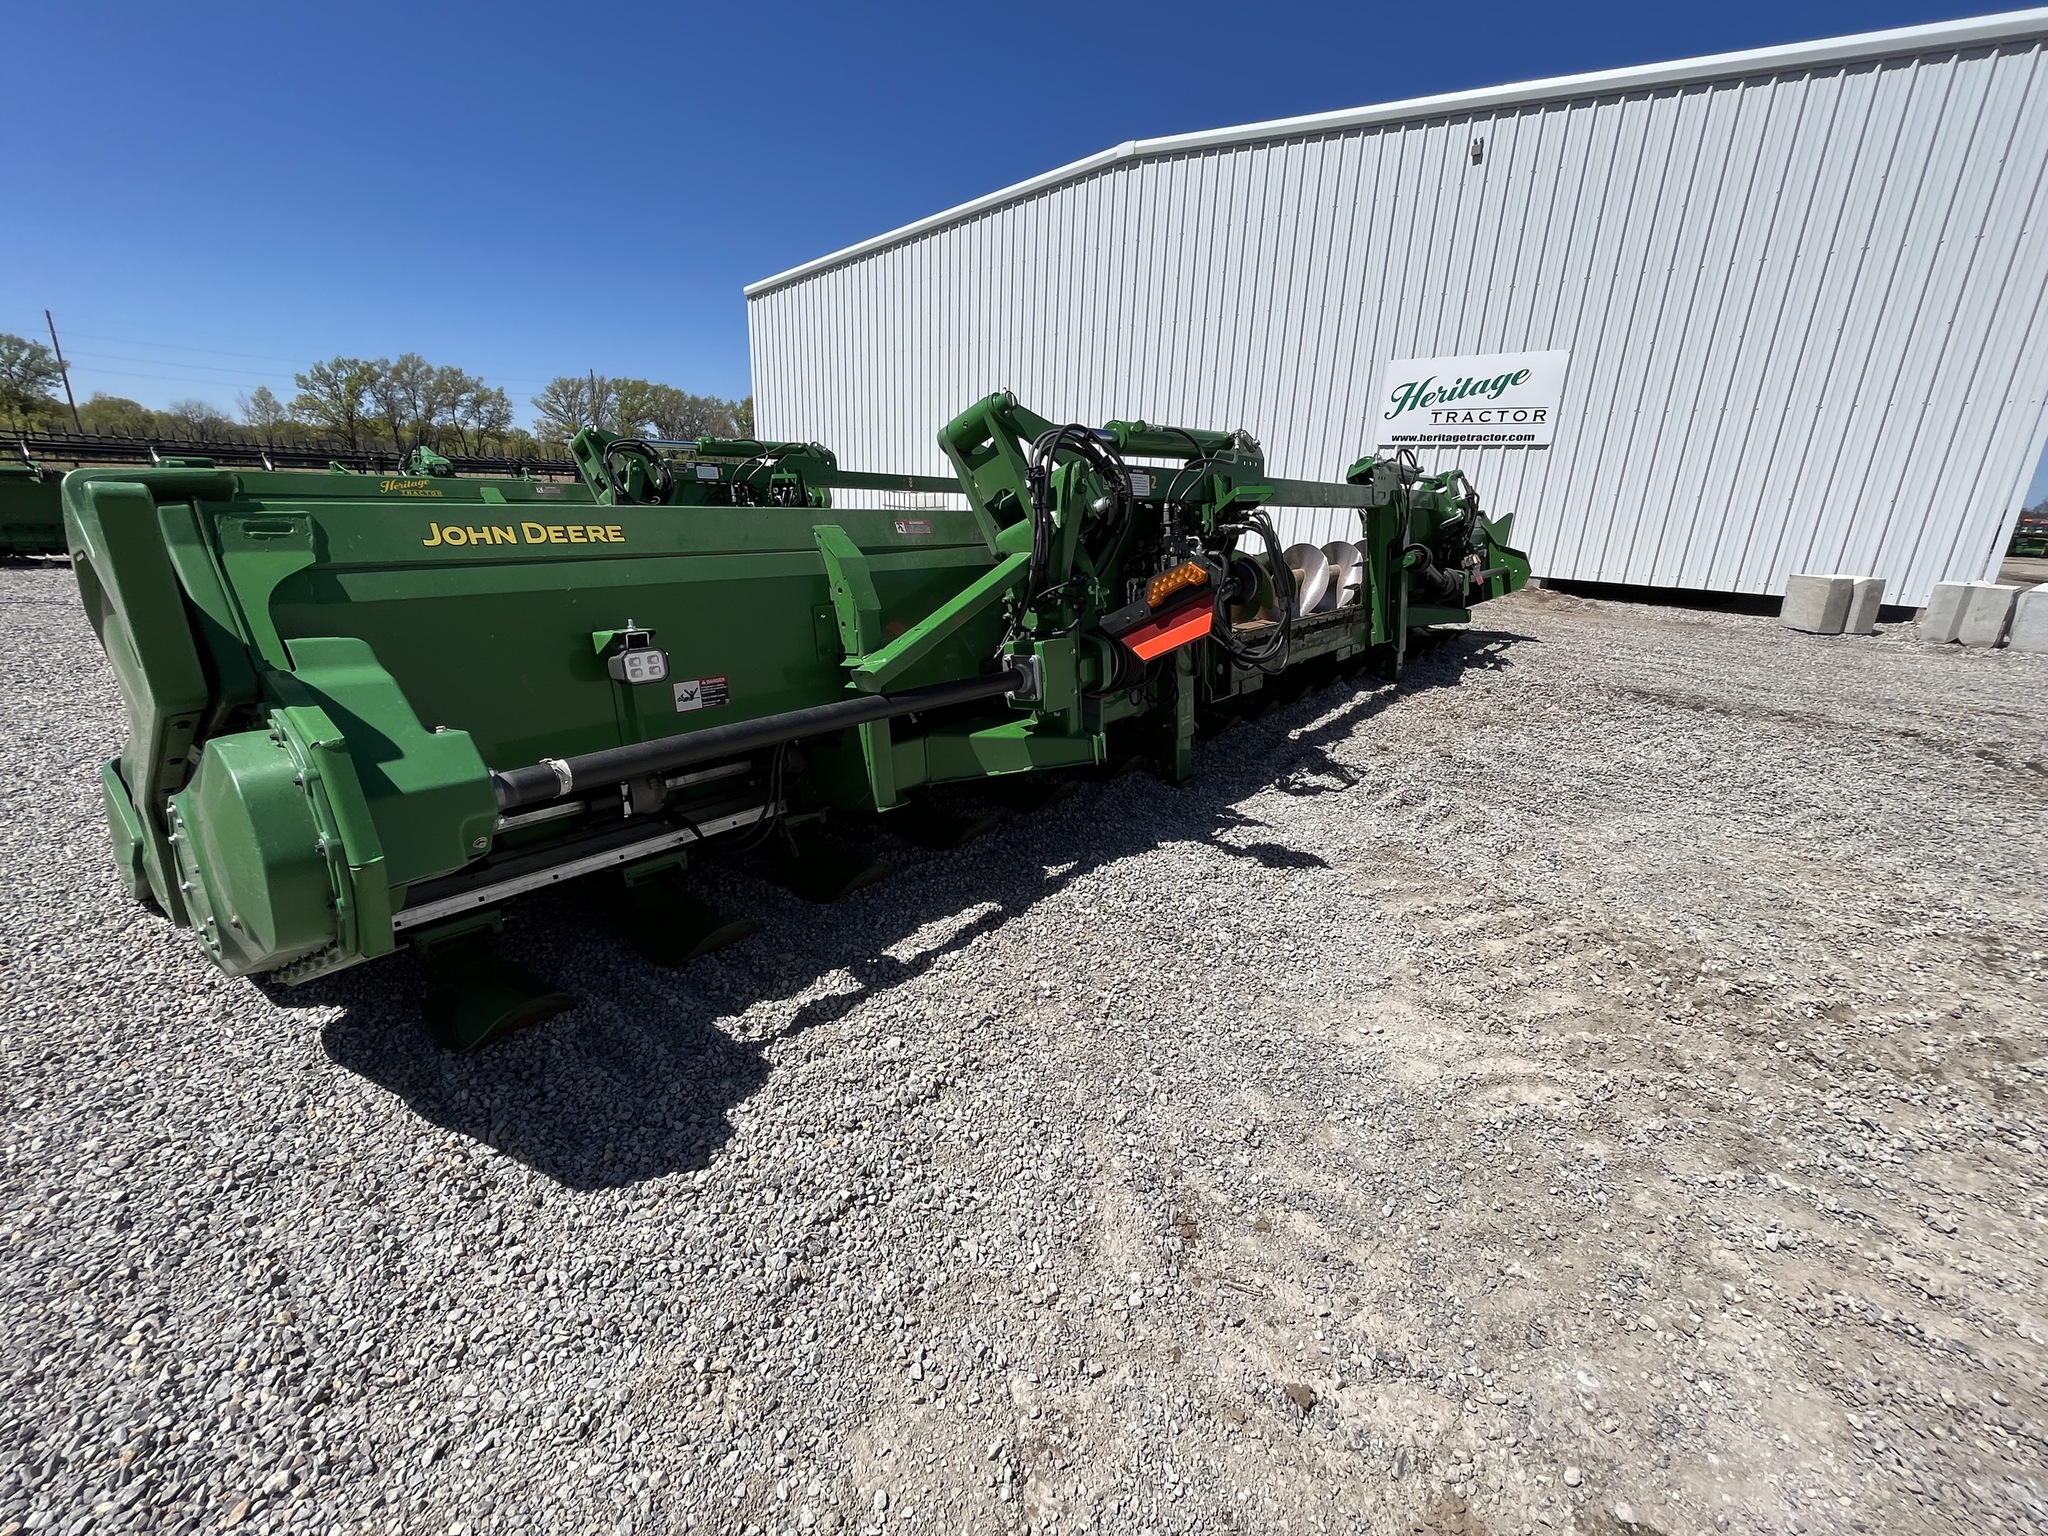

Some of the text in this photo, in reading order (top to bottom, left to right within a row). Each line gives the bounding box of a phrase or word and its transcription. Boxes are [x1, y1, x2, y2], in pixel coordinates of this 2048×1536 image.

[1384, 368, 1532, 419] Heritage
[1431, 410, 1547, 423] TRACTOR
[1391, 433, 1535, 443] www.heritagetractor.com
[380, 479, 430, 493] Heritage
[422, 521, 626, 546] JOHN DEERE
